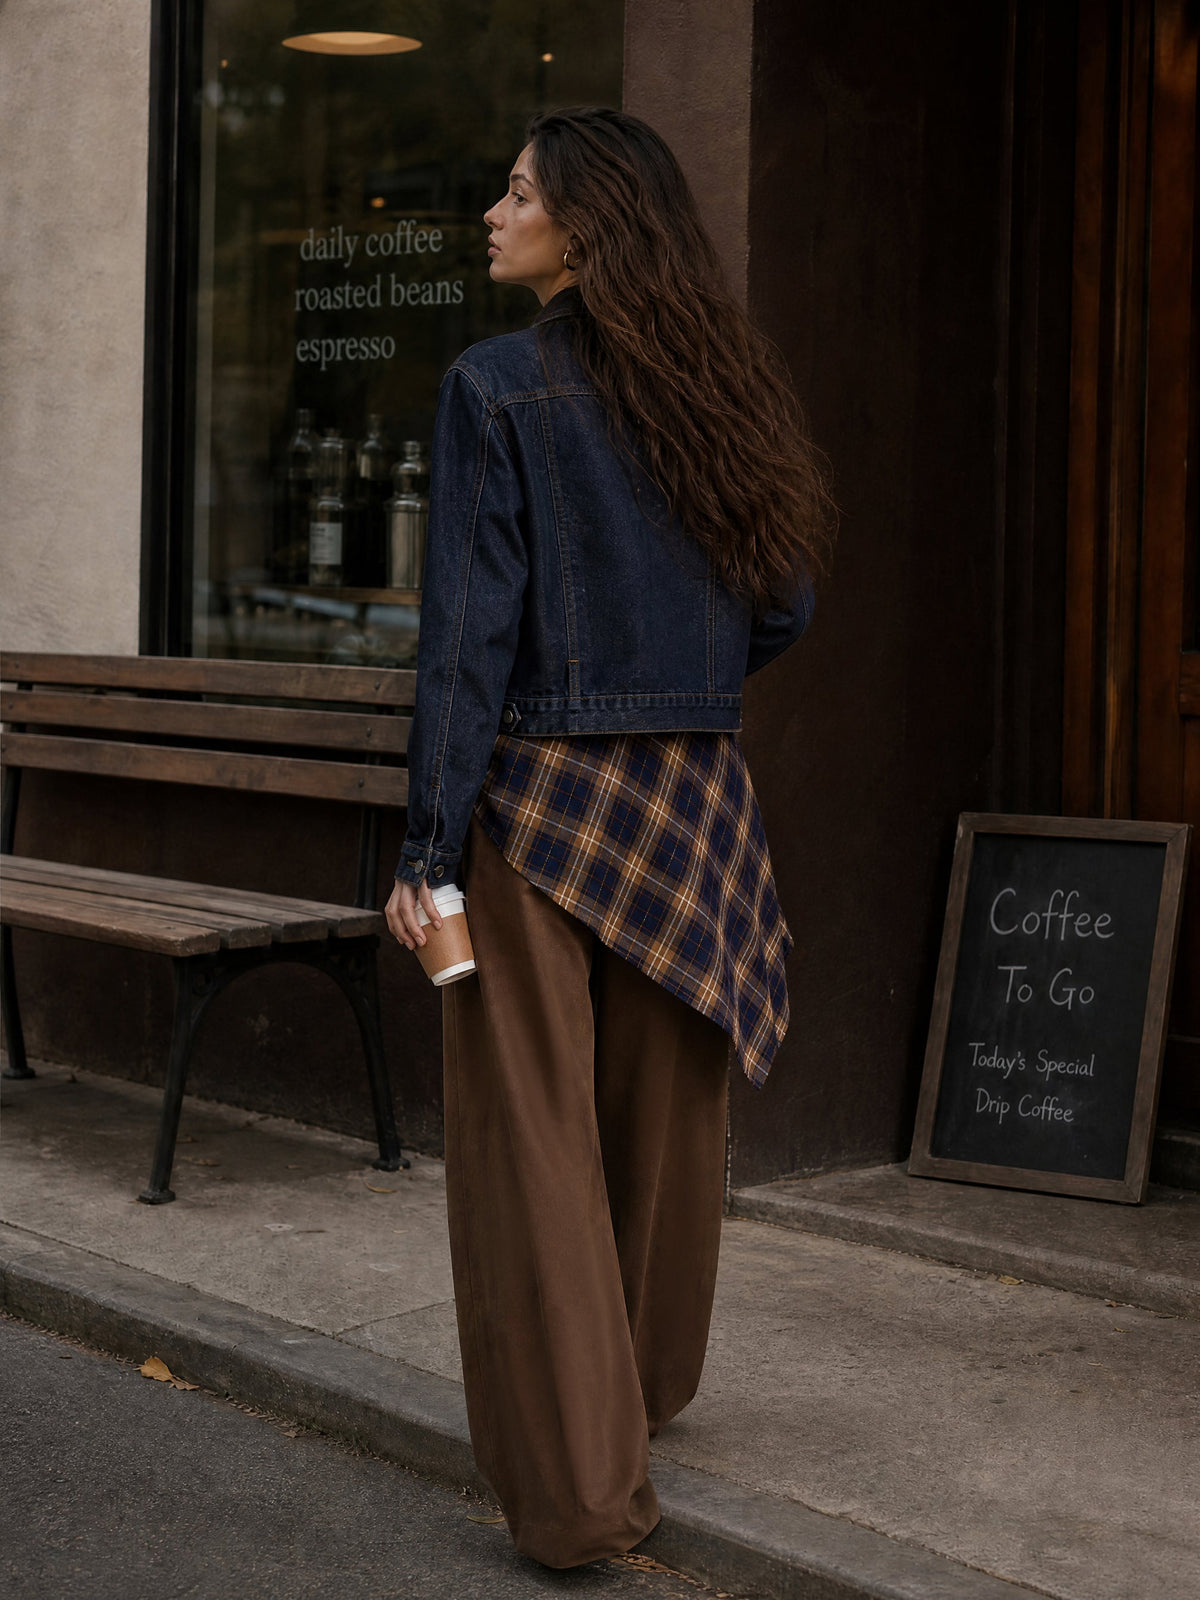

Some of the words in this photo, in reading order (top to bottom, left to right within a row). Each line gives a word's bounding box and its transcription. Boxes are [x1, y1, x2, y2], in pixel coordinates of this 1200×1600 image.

[299, 225, 360, 269] daily
[364, 218, 444, 258] coffee
[293, 273, 383, 313] roasted
[389, 272, 465, 308] beans
[295, 335, 397, 372] espresso
[989, 886, 1115, 941] Coffee
[997, 965, 1034, 1004] To
[1048, 967, 1096, 1011] Go
[968, 1042, 1027, 1080] Today's
[1035, 1049, 1097, 1082] Special
[975, 1087, 1011, 1125] Drip
[1017, 1094, 1075, 1123] Coffee
